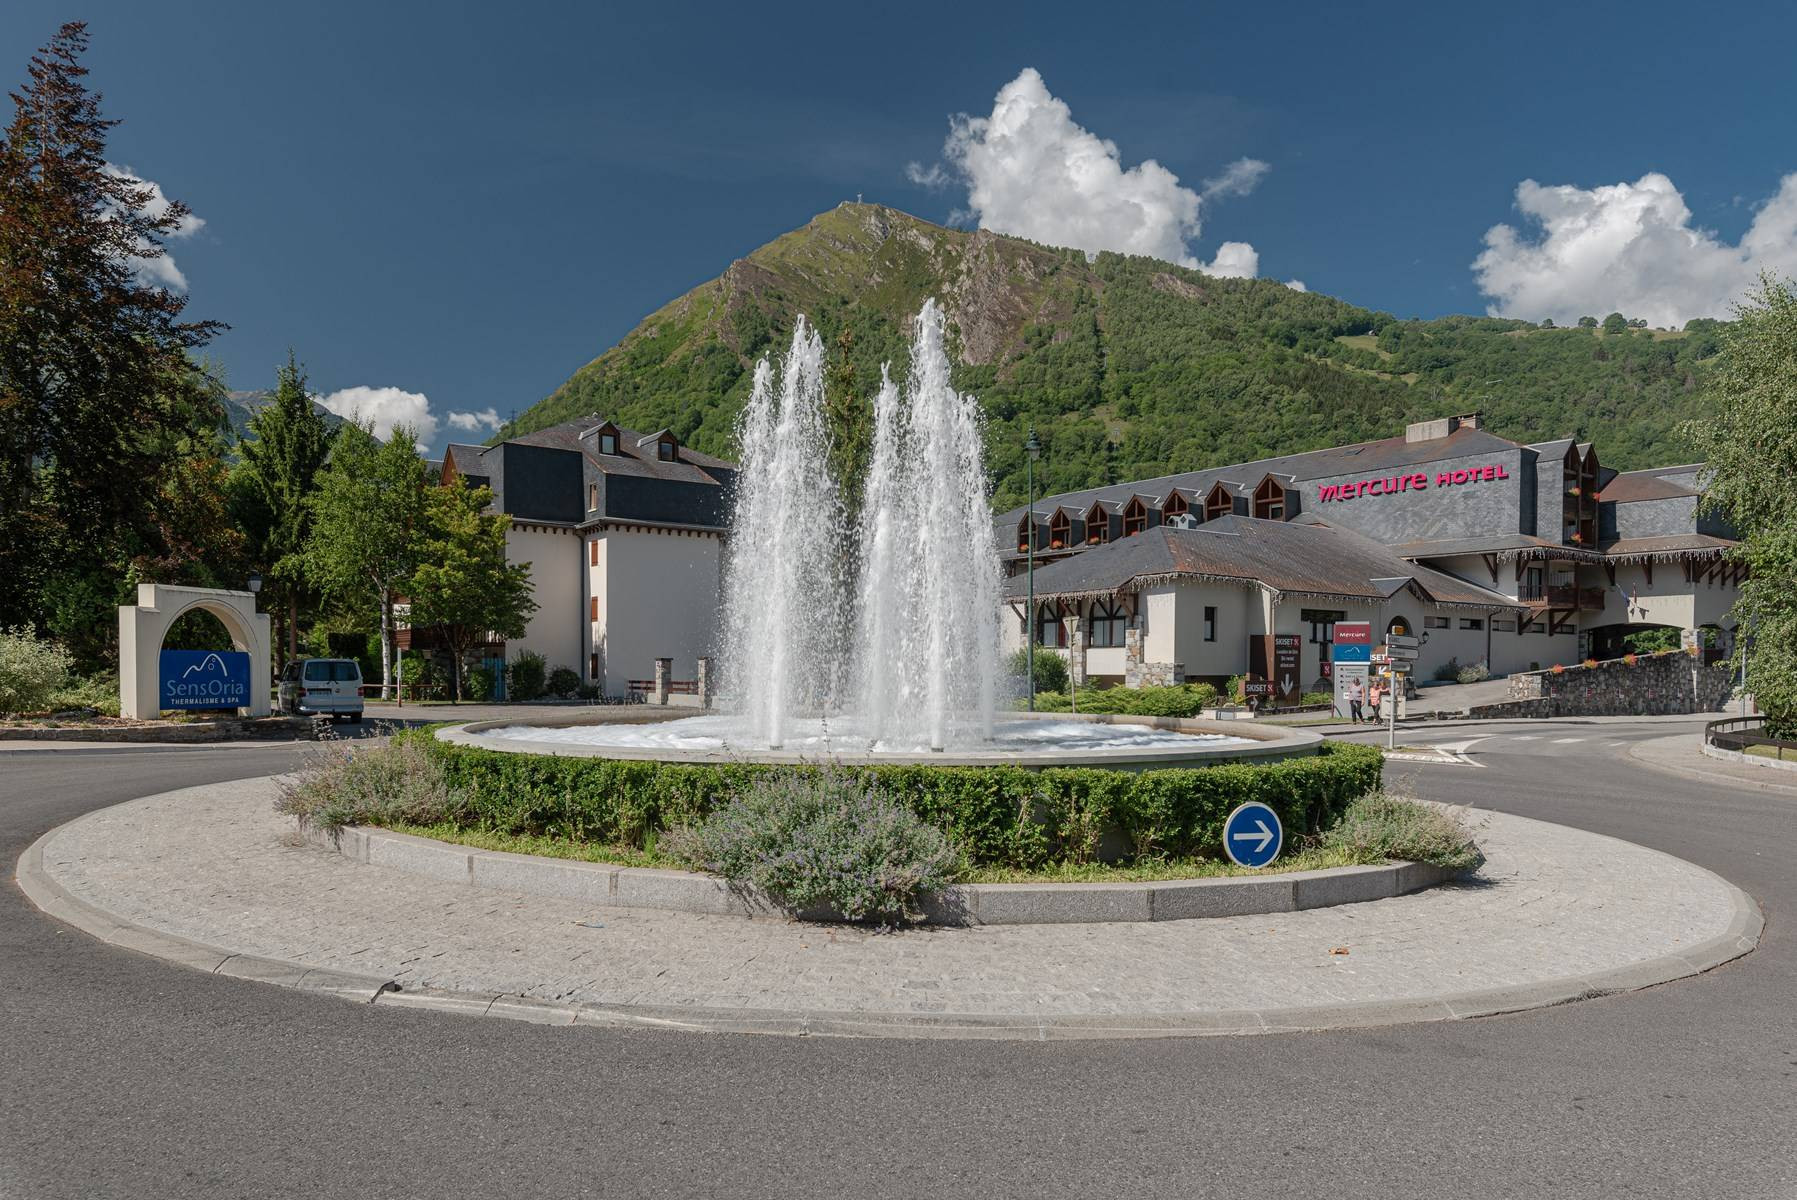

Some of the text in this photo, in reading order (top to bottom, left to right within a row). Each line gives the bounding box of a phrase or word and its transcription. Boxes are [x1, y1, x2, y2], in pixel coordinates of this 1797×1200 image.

[1437, 465, 1509, 487] HOTEL
[167, 680, 244, 696] SensOria
[1246, 684, 1266, 692] SKISET
